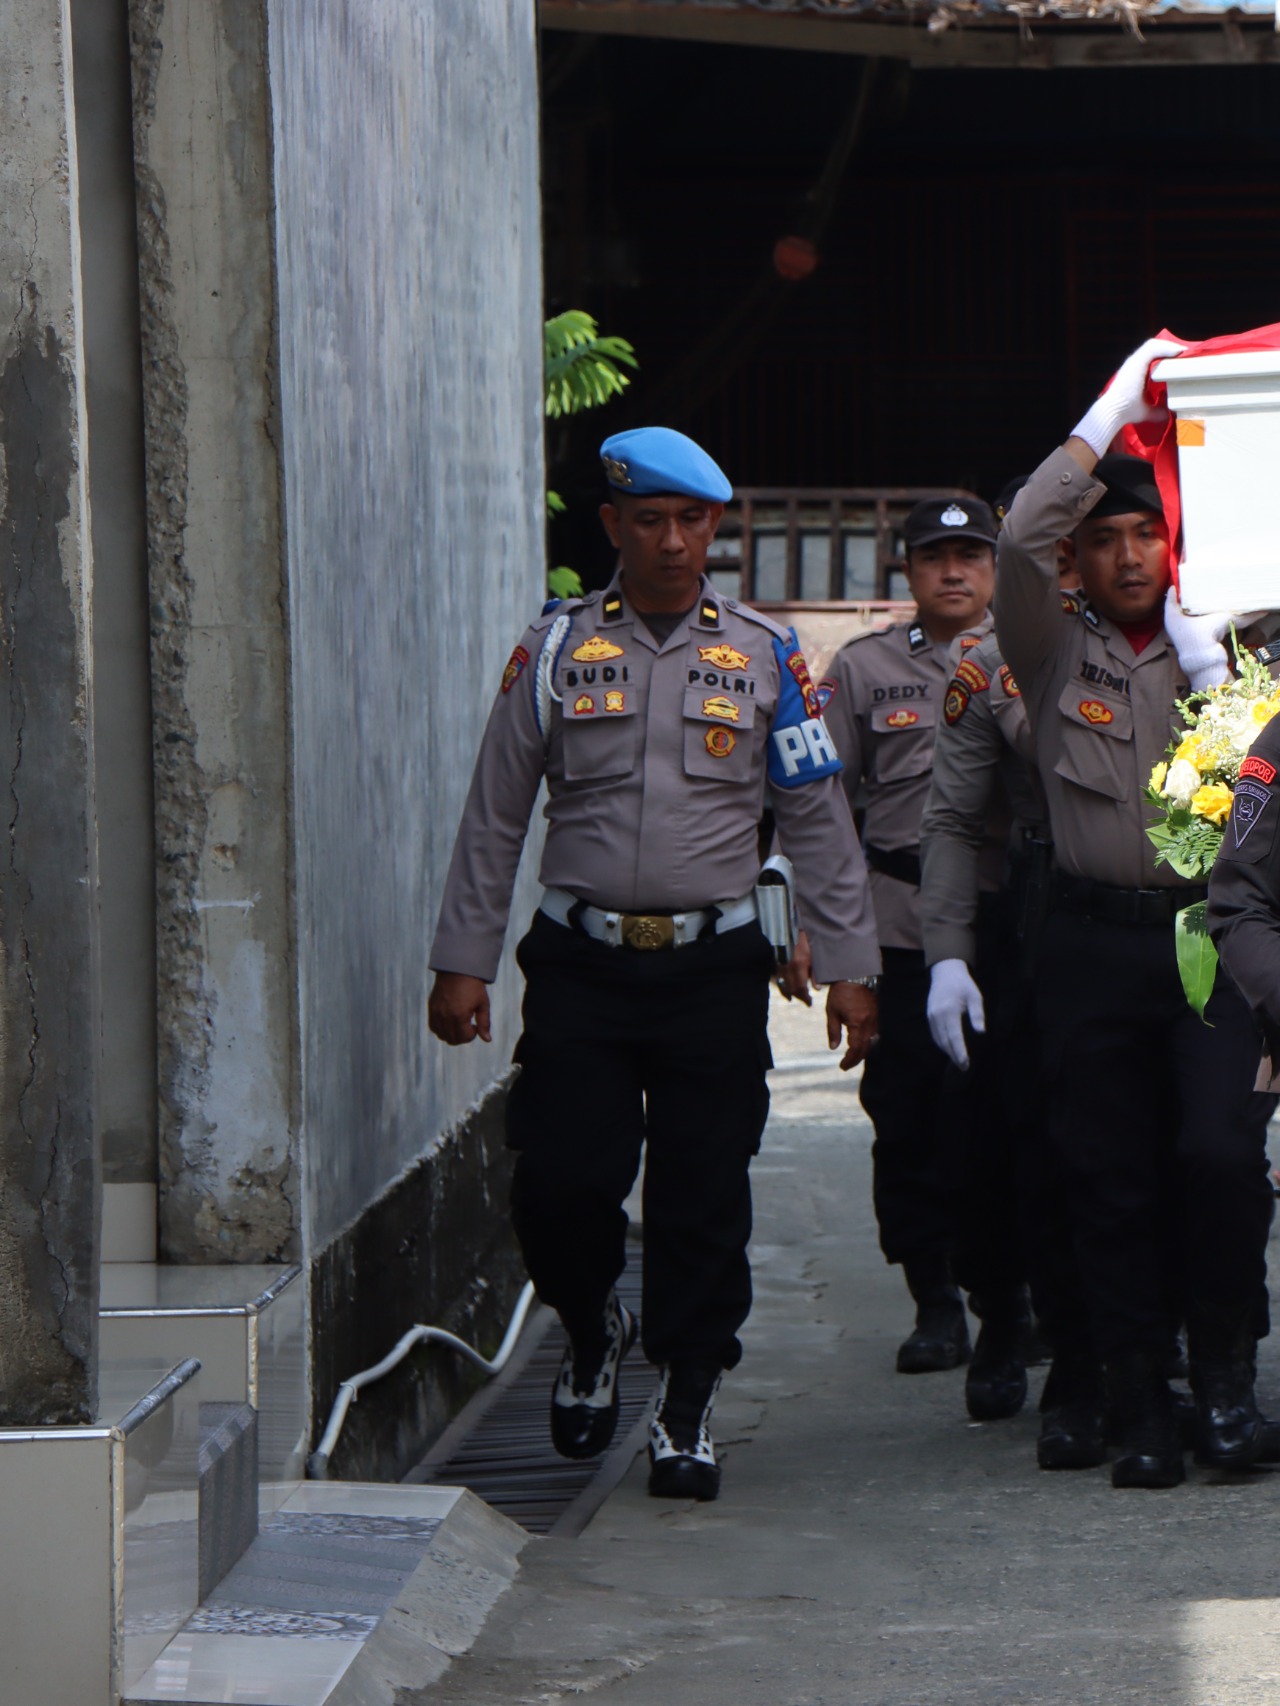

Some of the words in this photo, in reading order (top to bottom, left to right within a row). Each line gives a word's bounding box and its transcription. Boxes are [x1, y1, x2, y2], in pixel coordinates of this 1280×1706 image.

[567, 665, 628, 687] BUDI
[688, 669, 755, 695] POLRI
[873, 684, 929, 701] DEDY
